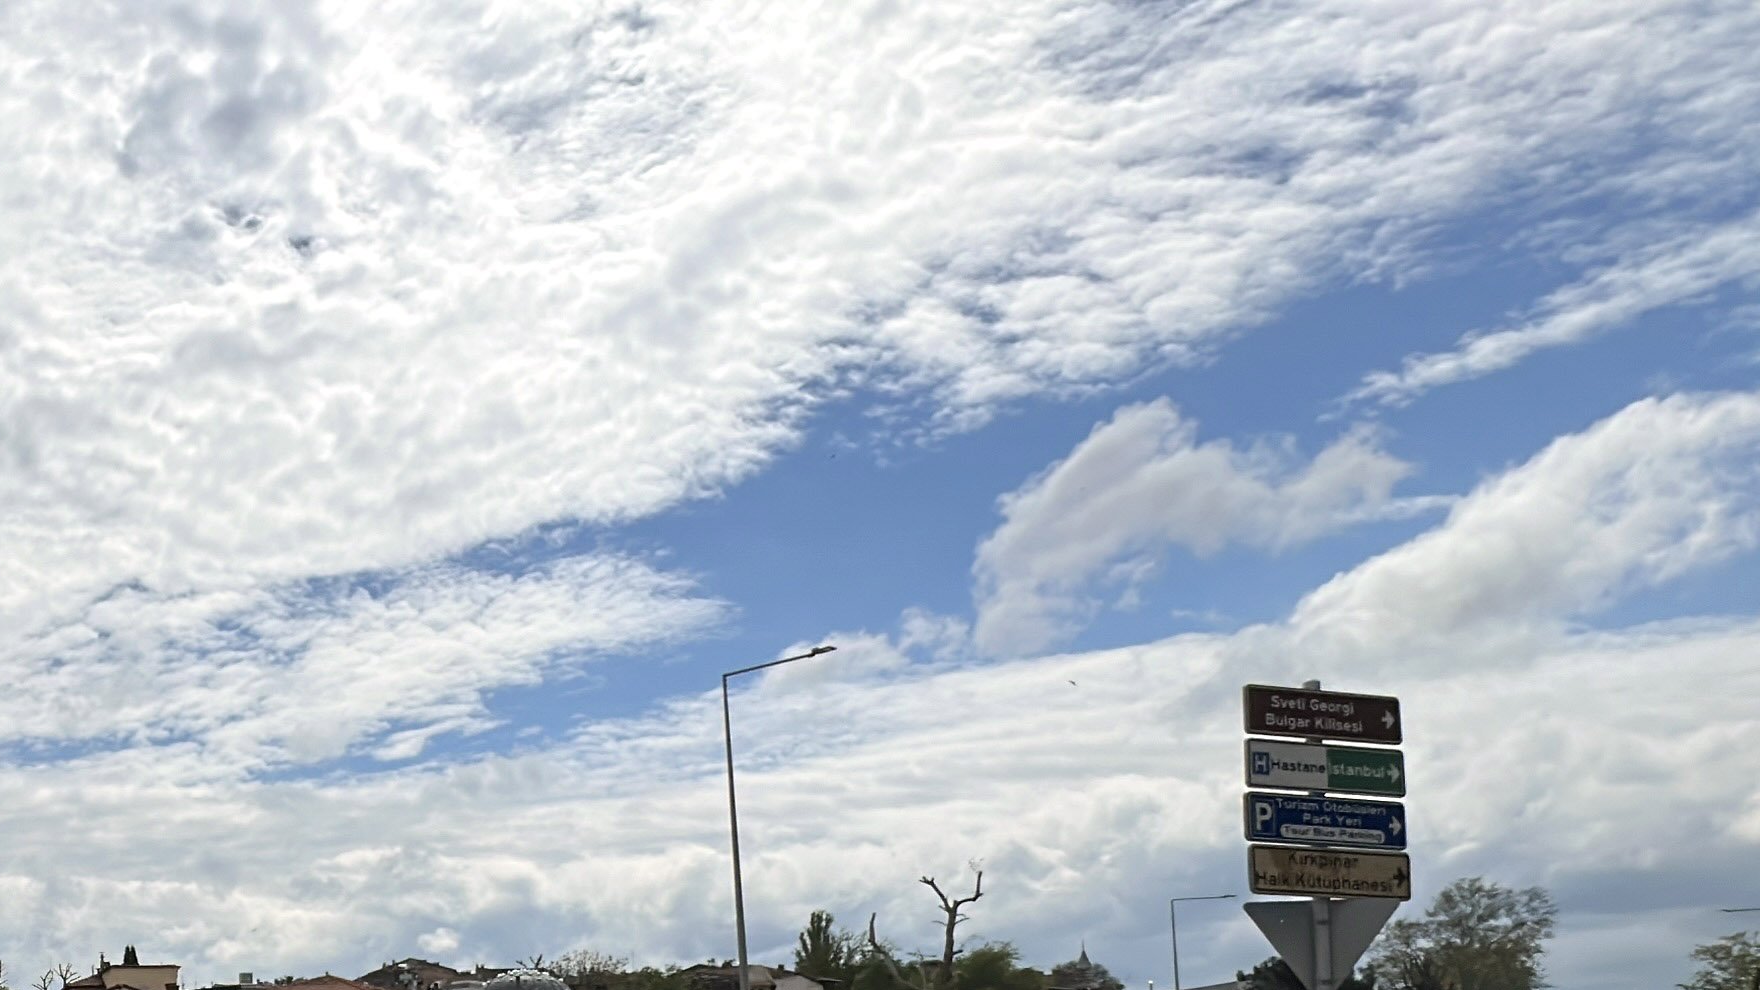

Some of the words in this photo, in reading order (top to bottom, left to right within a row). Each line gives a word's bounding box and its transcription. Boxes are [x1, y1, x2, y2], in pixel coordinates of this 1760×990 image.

[1271, 695, 1306, 710] Sveti
[1310, 698, 1355, 716] Georgi
[1265, 713, 1310, 730] Bulgar
[1271, 759, 1326, 774] Hastane
[1254, 802, 1273, 831] P
[1302, 812, 1331, 825] Park
